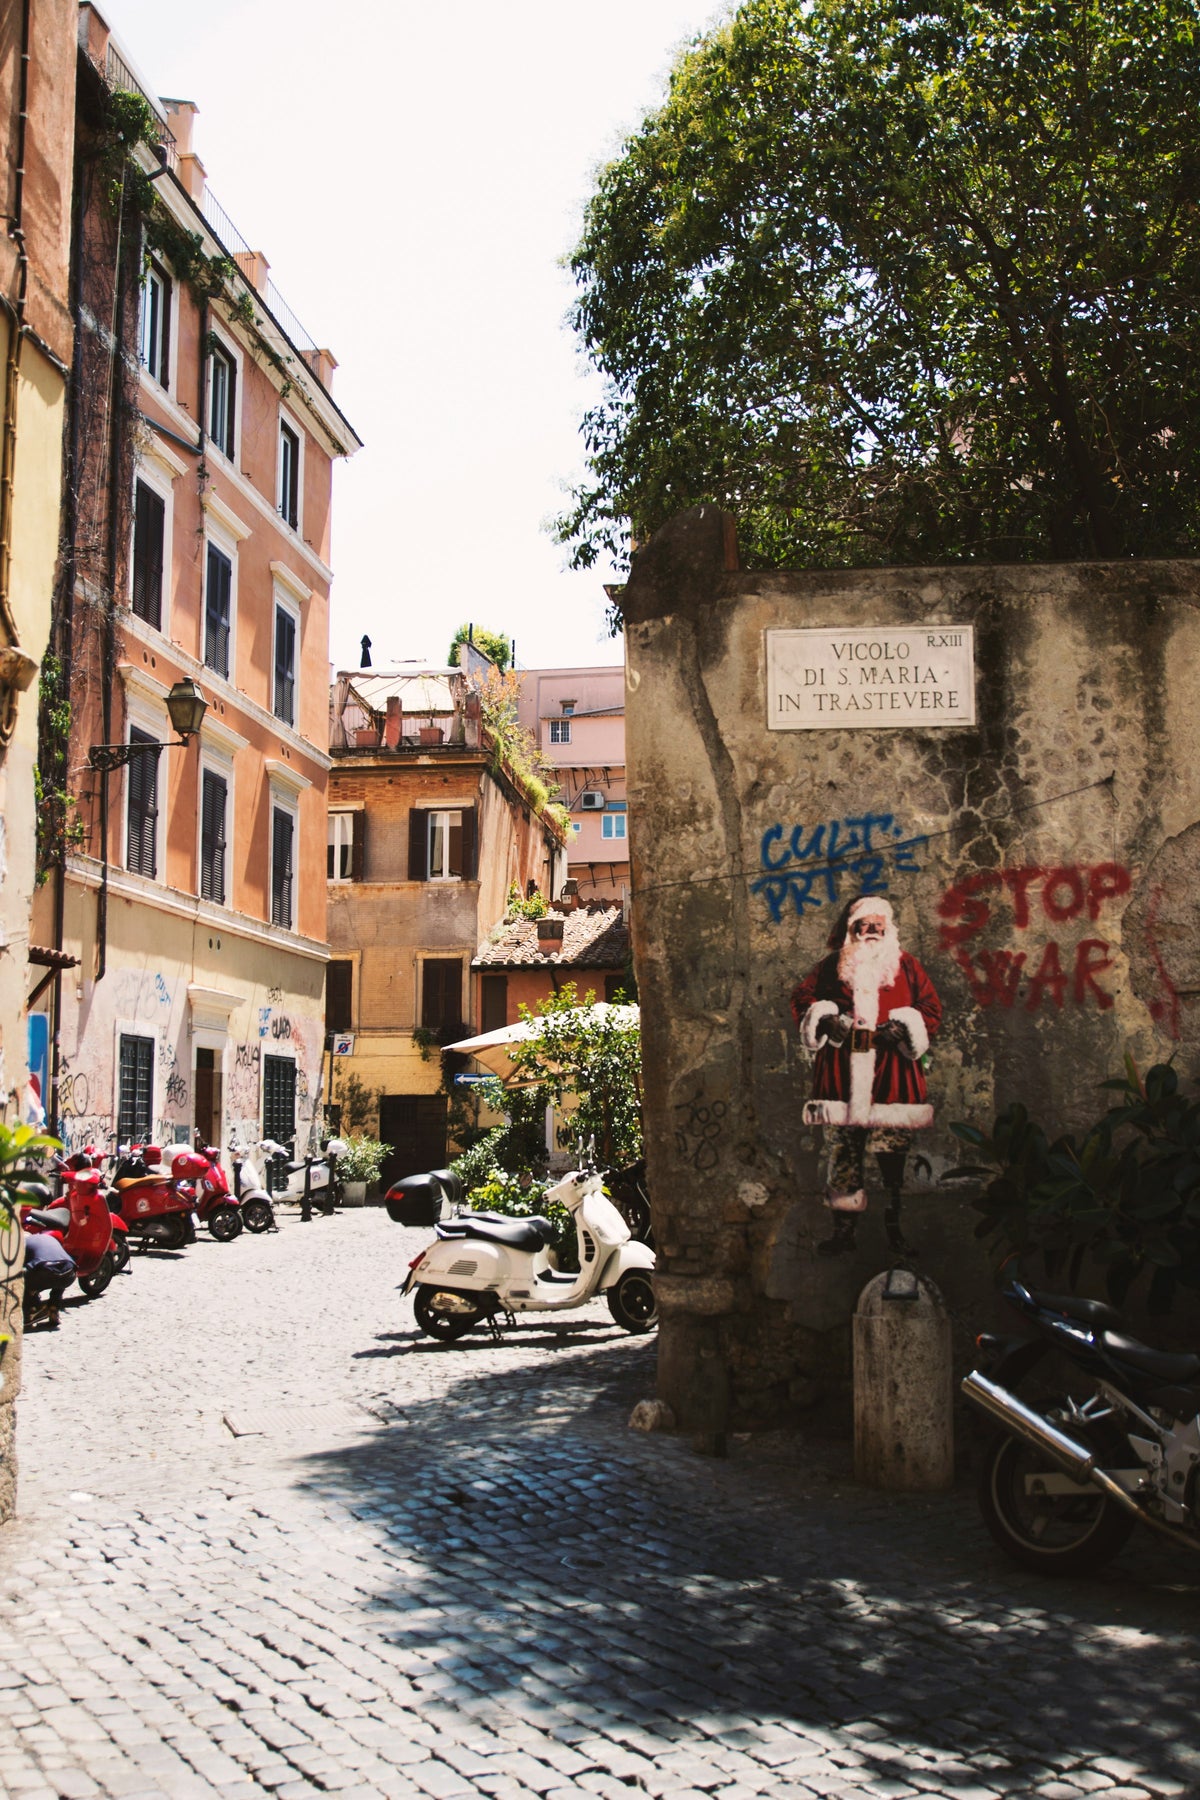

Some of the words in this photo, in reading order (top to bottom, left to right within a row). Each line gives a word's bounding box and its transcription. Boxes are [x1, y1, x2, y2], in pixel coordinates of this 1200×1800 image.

[831, 641, 911, 661] VICOLO
[803, 667, 825, 686] DI
[837, 667, 852, 686] S.
[859, 665, 939, 685] MARIA
[778, 692, 801, 712] IN
[812, 690, 960, 712] TRASTEVERE
[937, 861, 1132, 949] STOP
[956, 938, 1115, 1012] WAR
